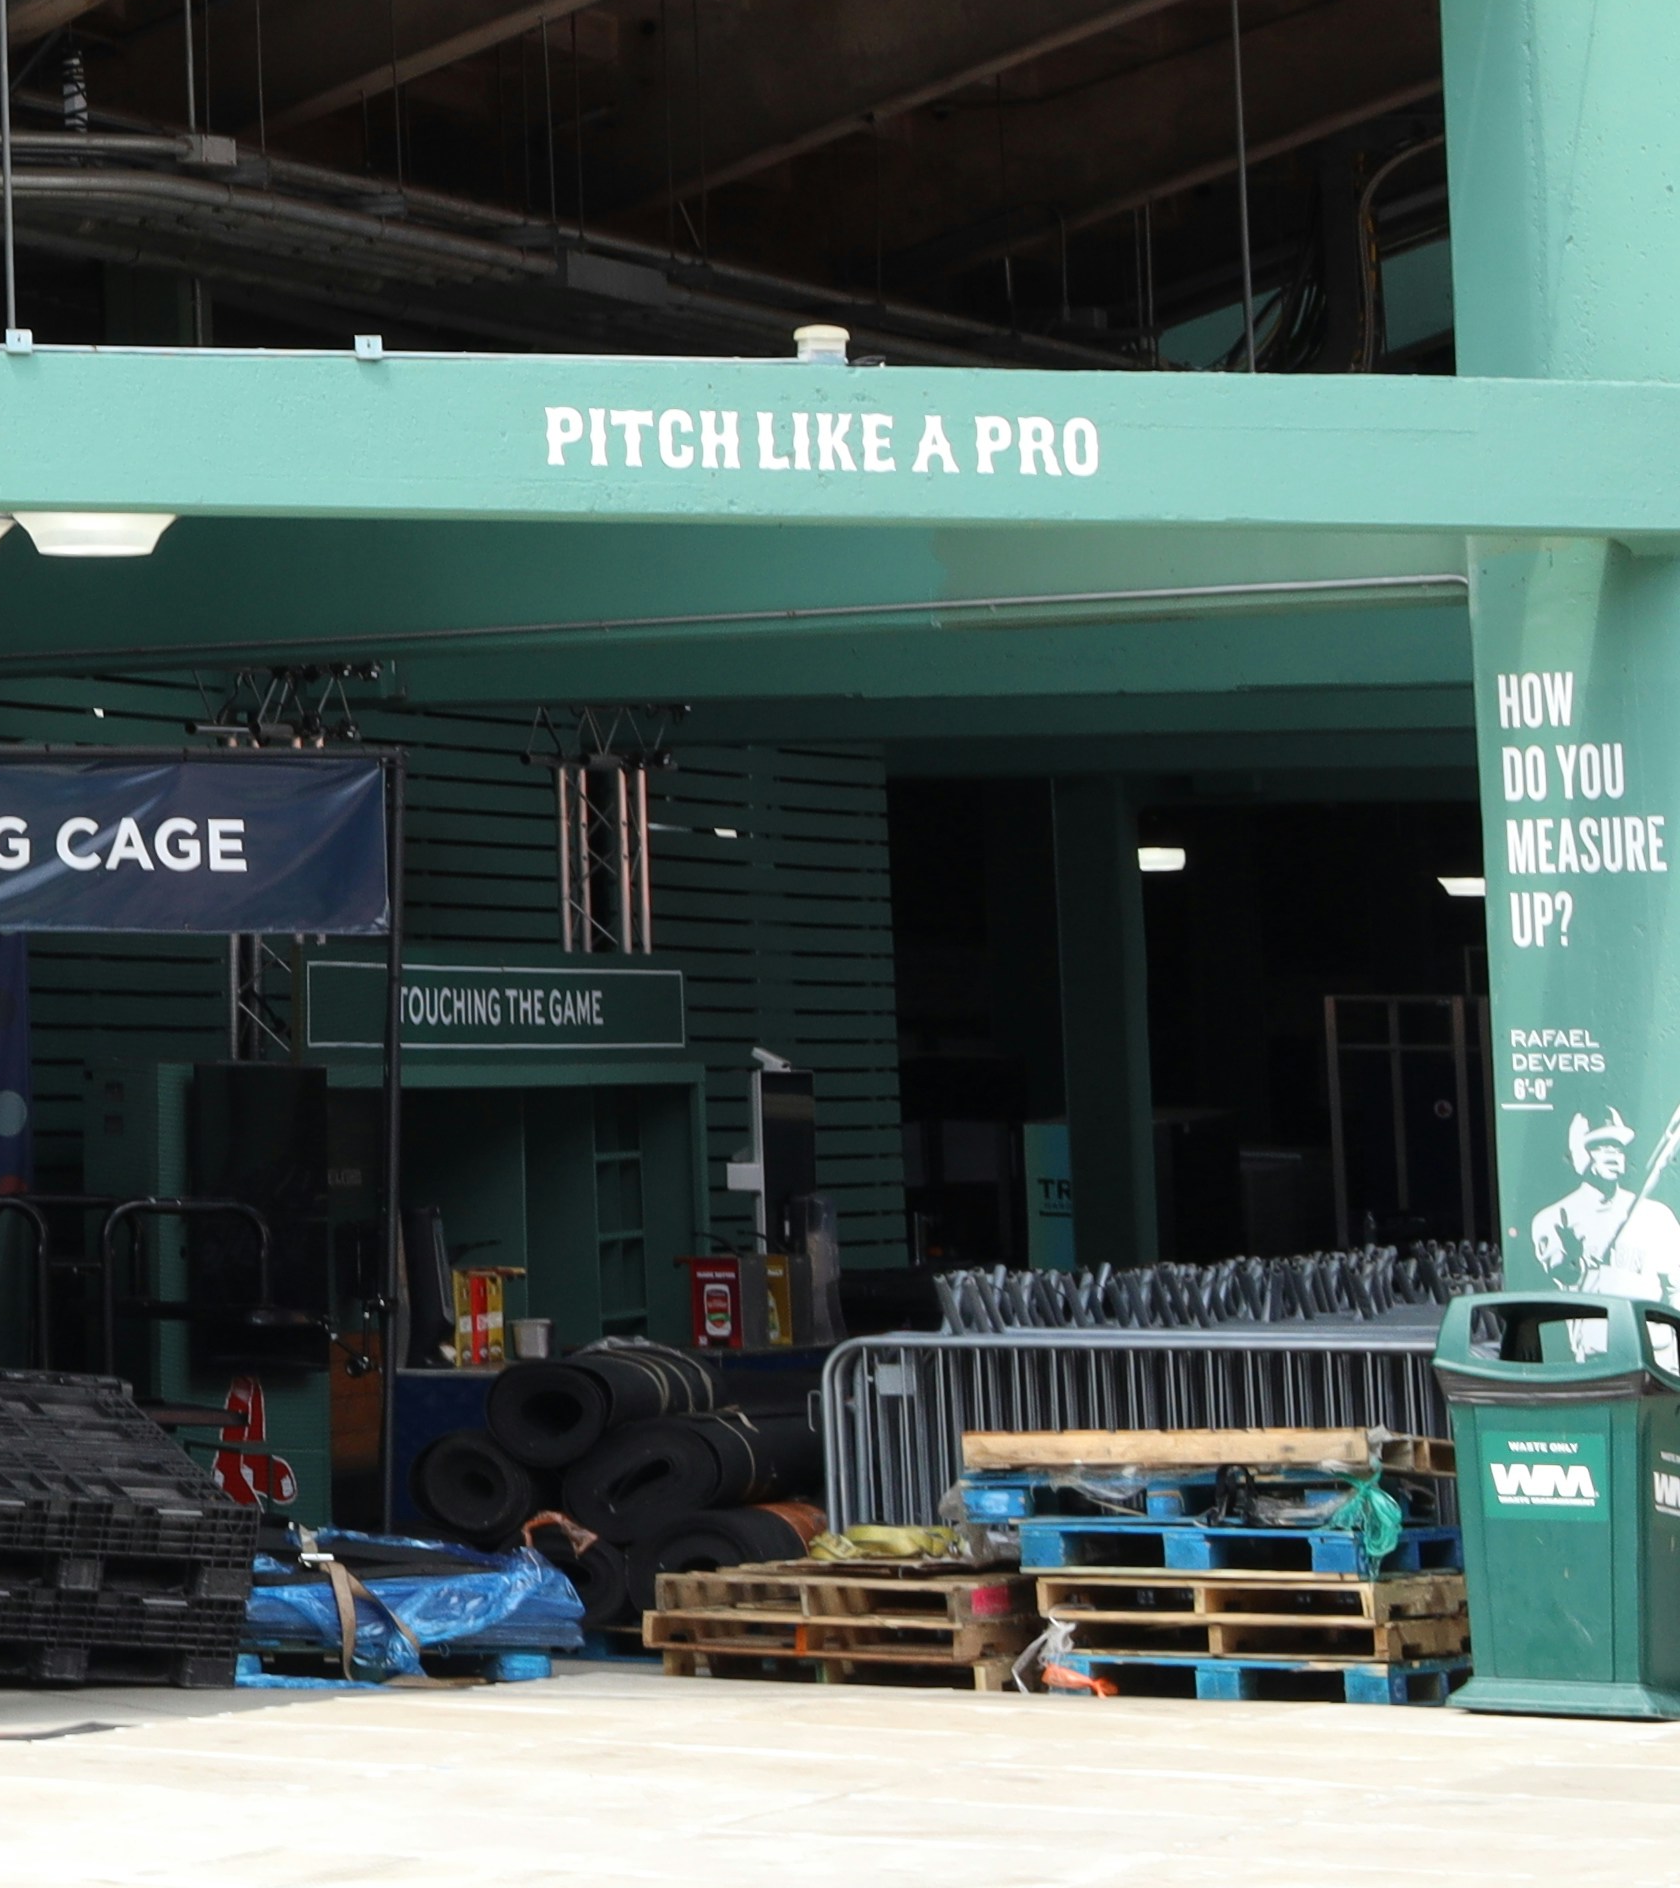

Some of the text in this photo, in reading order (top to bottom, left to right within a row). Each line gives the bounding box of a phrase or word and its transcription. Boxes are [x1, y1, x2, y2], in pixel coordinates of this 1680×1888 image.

[544, 405, 1101, 478] PITCH LIKE A PRO
[1497, 671, 1574, 729] HOW
[1501, 742, 1625, 802] DO YOU
[55, 815, 250, 874] CAGE
[1506, 815, 1668, 875] MEASURE
[1509, 890, 1574, 949] UP?
[400, 985, 605, 1027] TOUCHING THE GAME
[1510, 1028, 1601, 1050] RAFAEL
[1512, 1051, 1606, 1074] DEVERS
[1507, 1440, 1579, 1454] WASTE ONLY
[1489, 1463, 1597, 1499] WM
